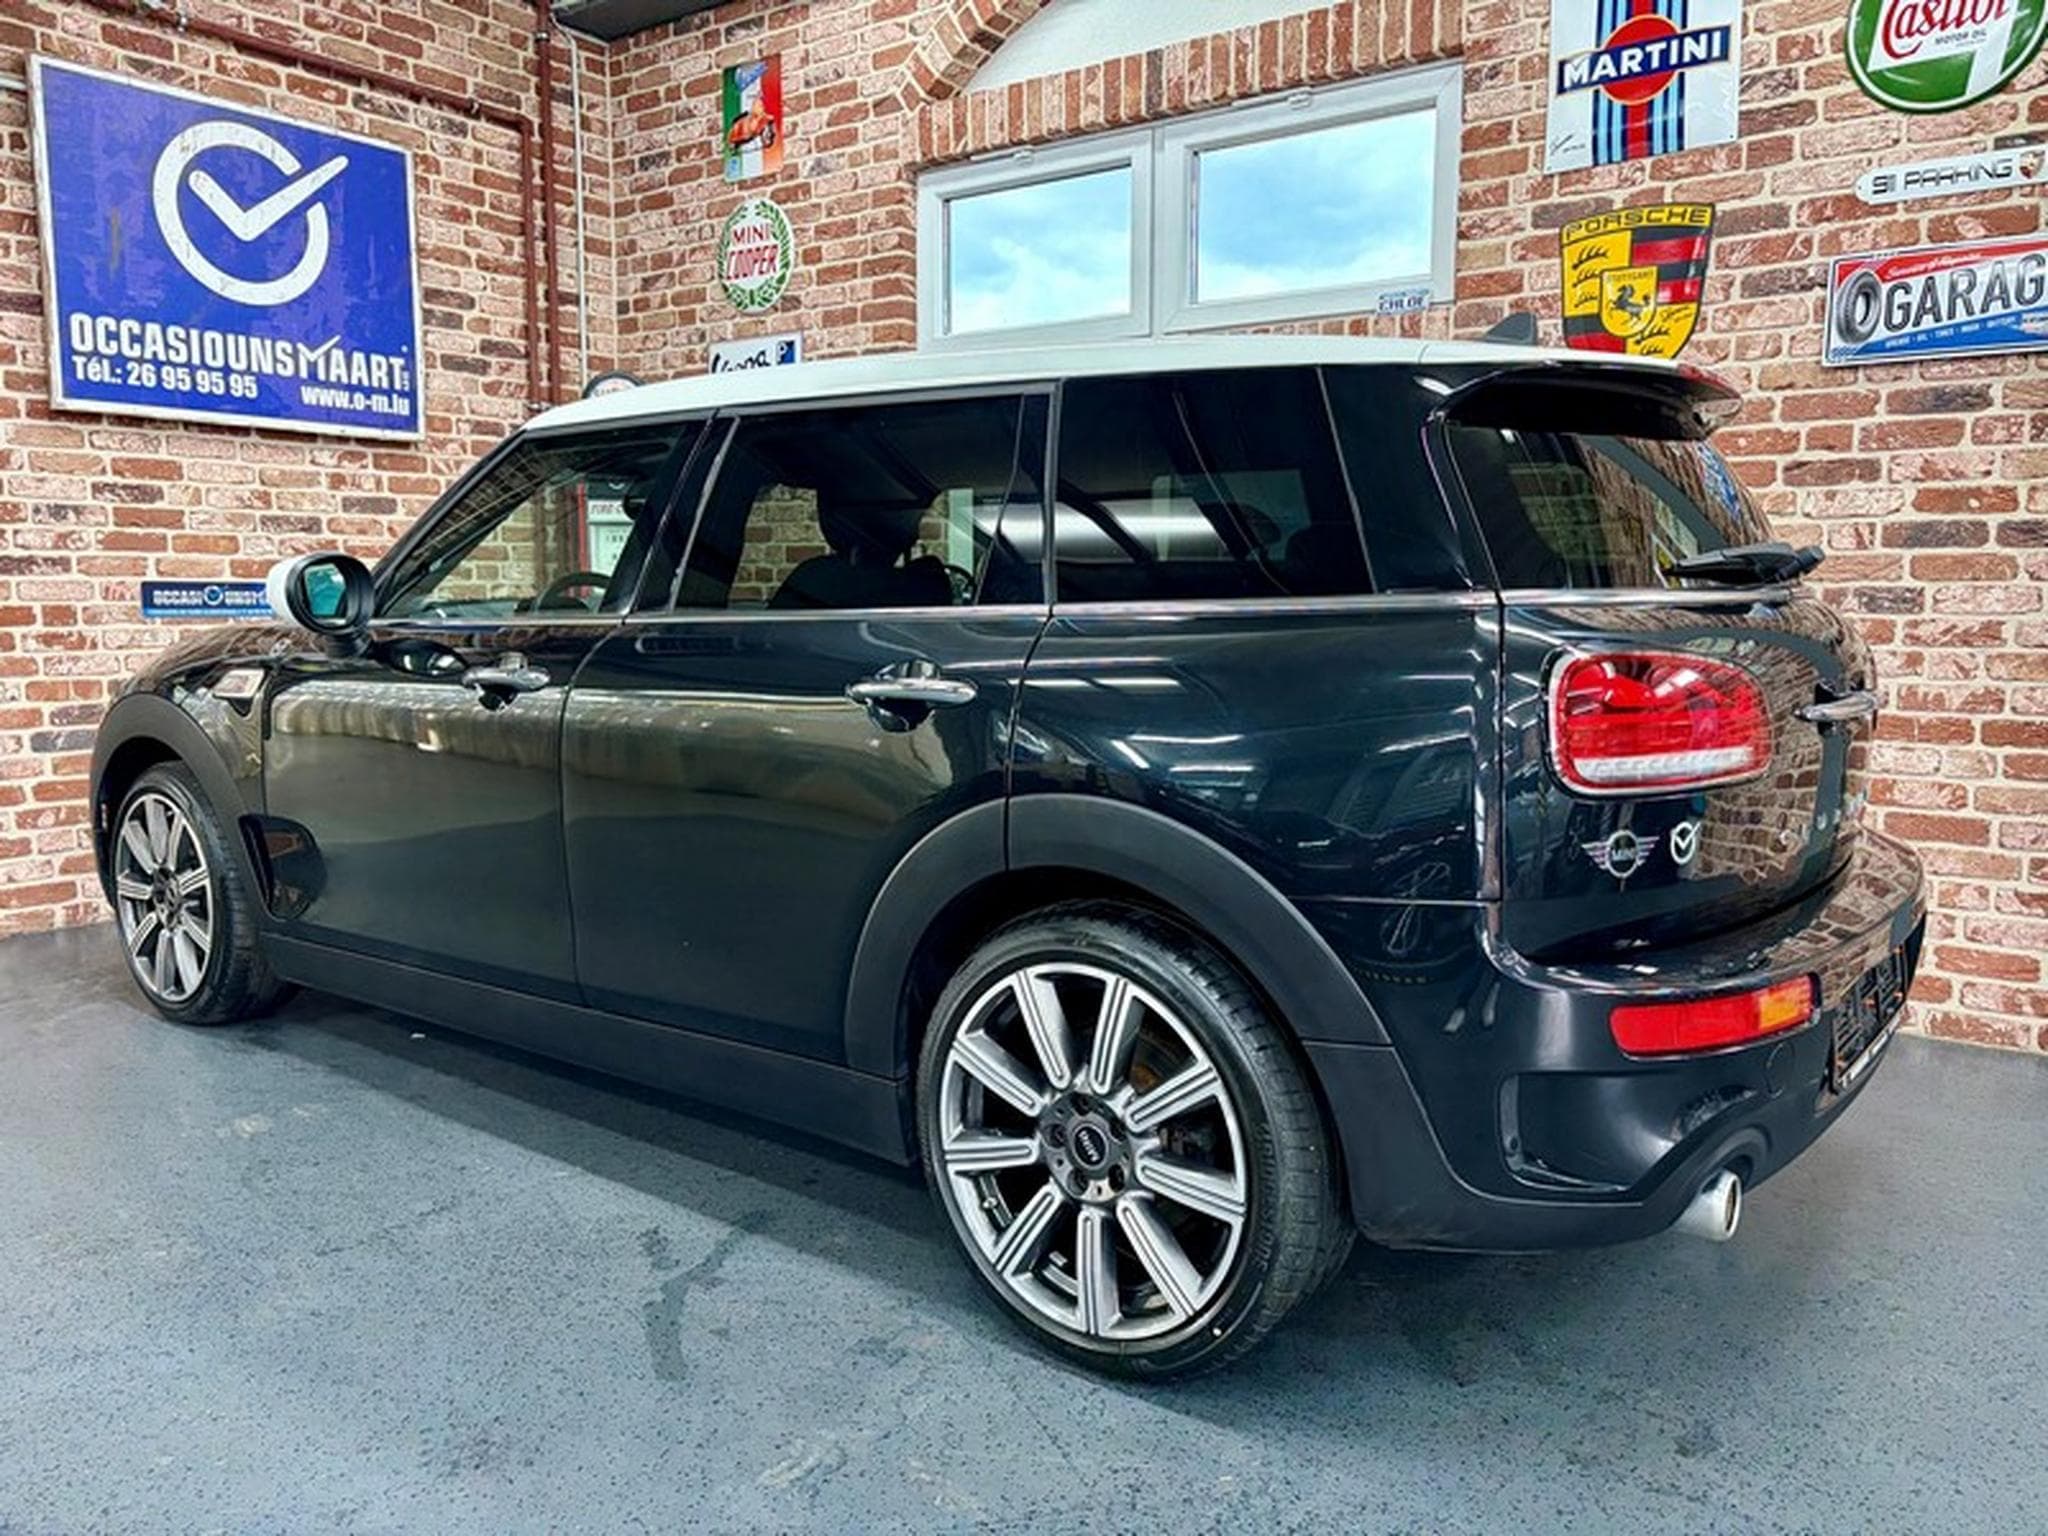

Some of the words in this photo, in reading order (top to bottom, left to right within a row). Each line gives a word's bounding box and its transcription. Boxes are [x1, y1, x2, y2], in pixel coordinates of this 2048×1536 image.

[1563, 31, 1722, 88] MARTINI
[1904, 158, 2013, 190] PARKING
[733, 223, 770, 244] MINI
[1566, 208, 1708, 241] PORSCHE
[726, 244, 779, 280] COOPER
[1883, 253, 2047, 333] GARAG
[69, 312, 405, 391] OCCASIOUNSMAART
[126, 361, 158, 388] 26
[161, 365, 192, 392] 95
[195, 369, 226, 396] 95
[229, 373, 259, 399] 95
[300, 385, 411, 416] www.o-m.lu
